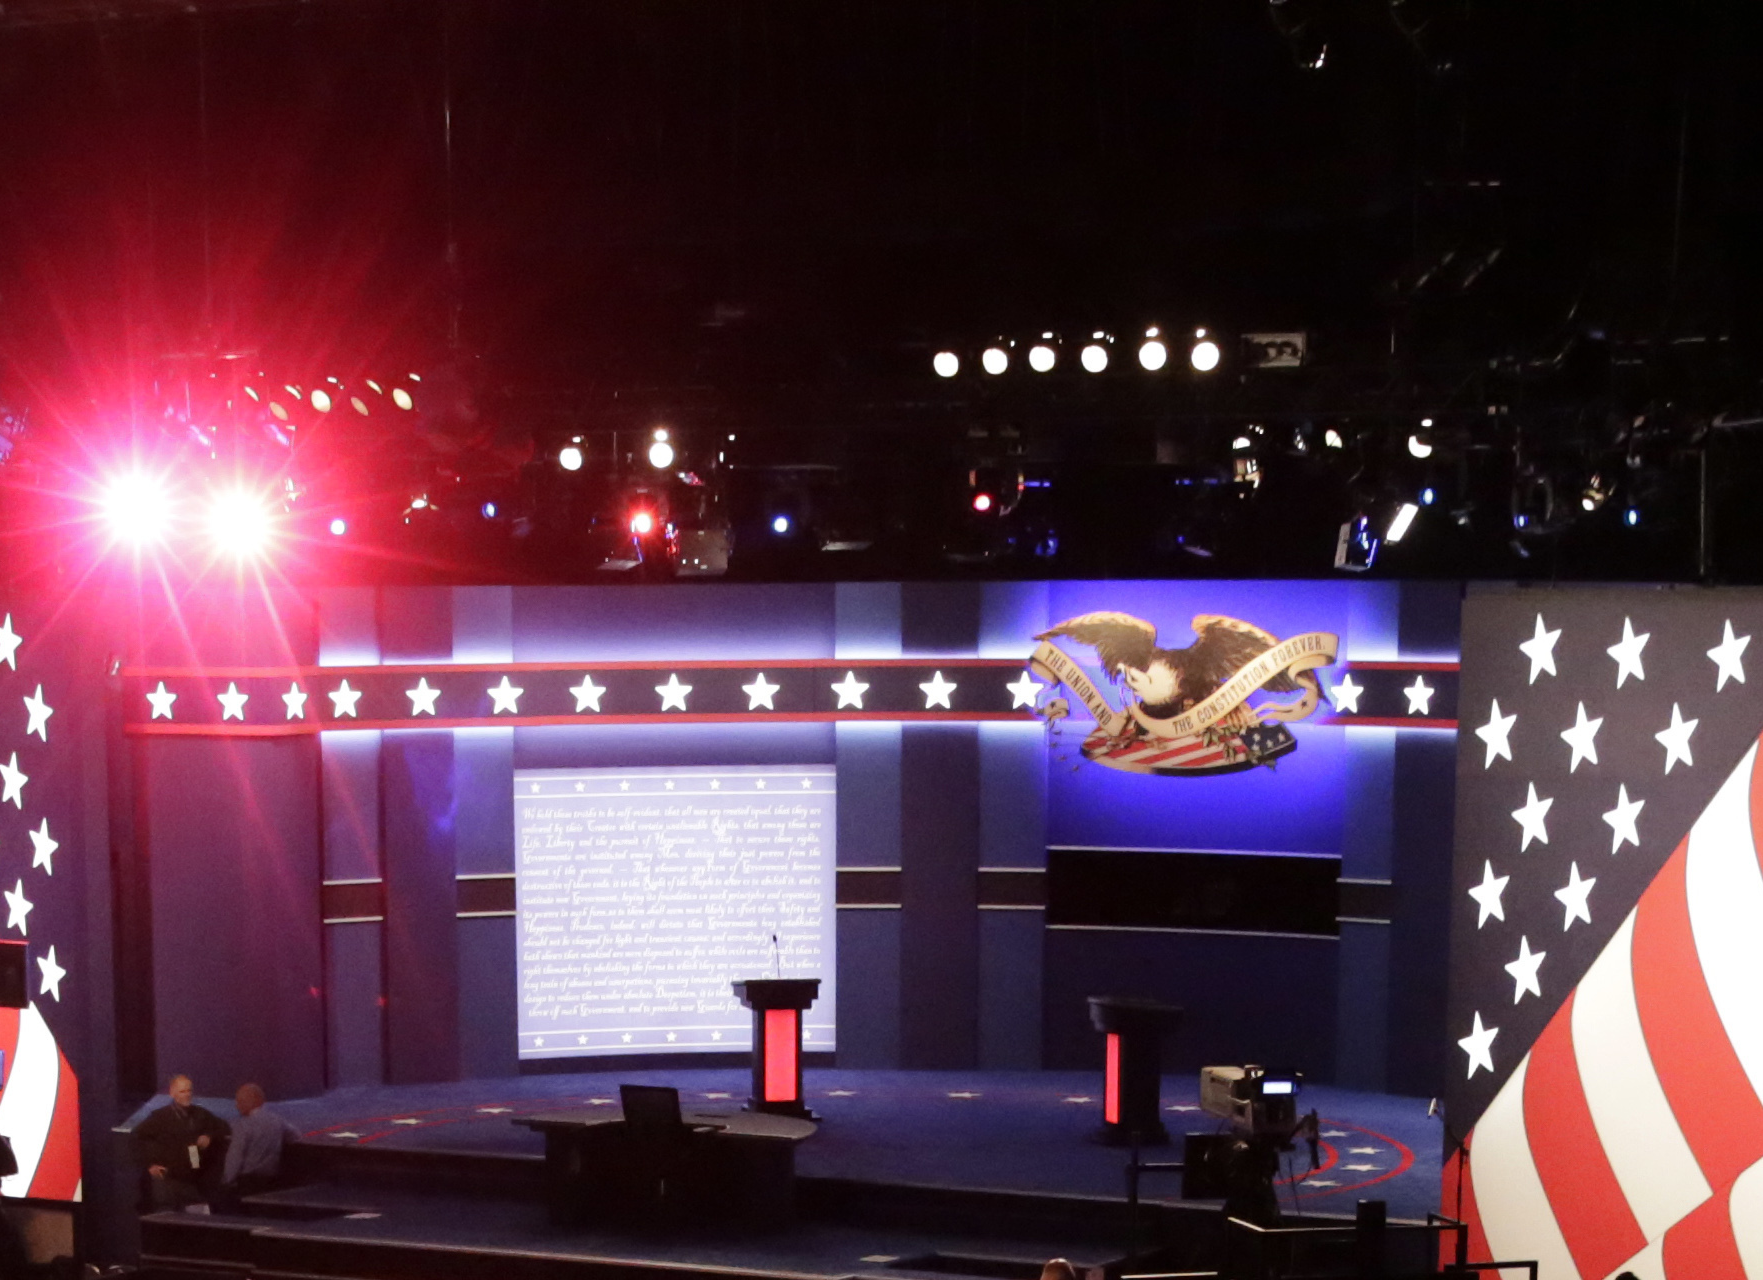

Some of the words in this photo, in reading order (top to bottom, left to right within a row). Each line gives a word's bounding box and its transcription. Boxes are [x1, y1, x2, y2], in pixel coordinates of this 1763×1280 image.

[1044, 649, 1067, 672] THE
[1065, 666, 1095, 704] UNION
[1089, 700, 1112, 726] AND
[1172, 717, 1194, 735] THE
[1197, 663, 1269, 722] CONSTITUTION
